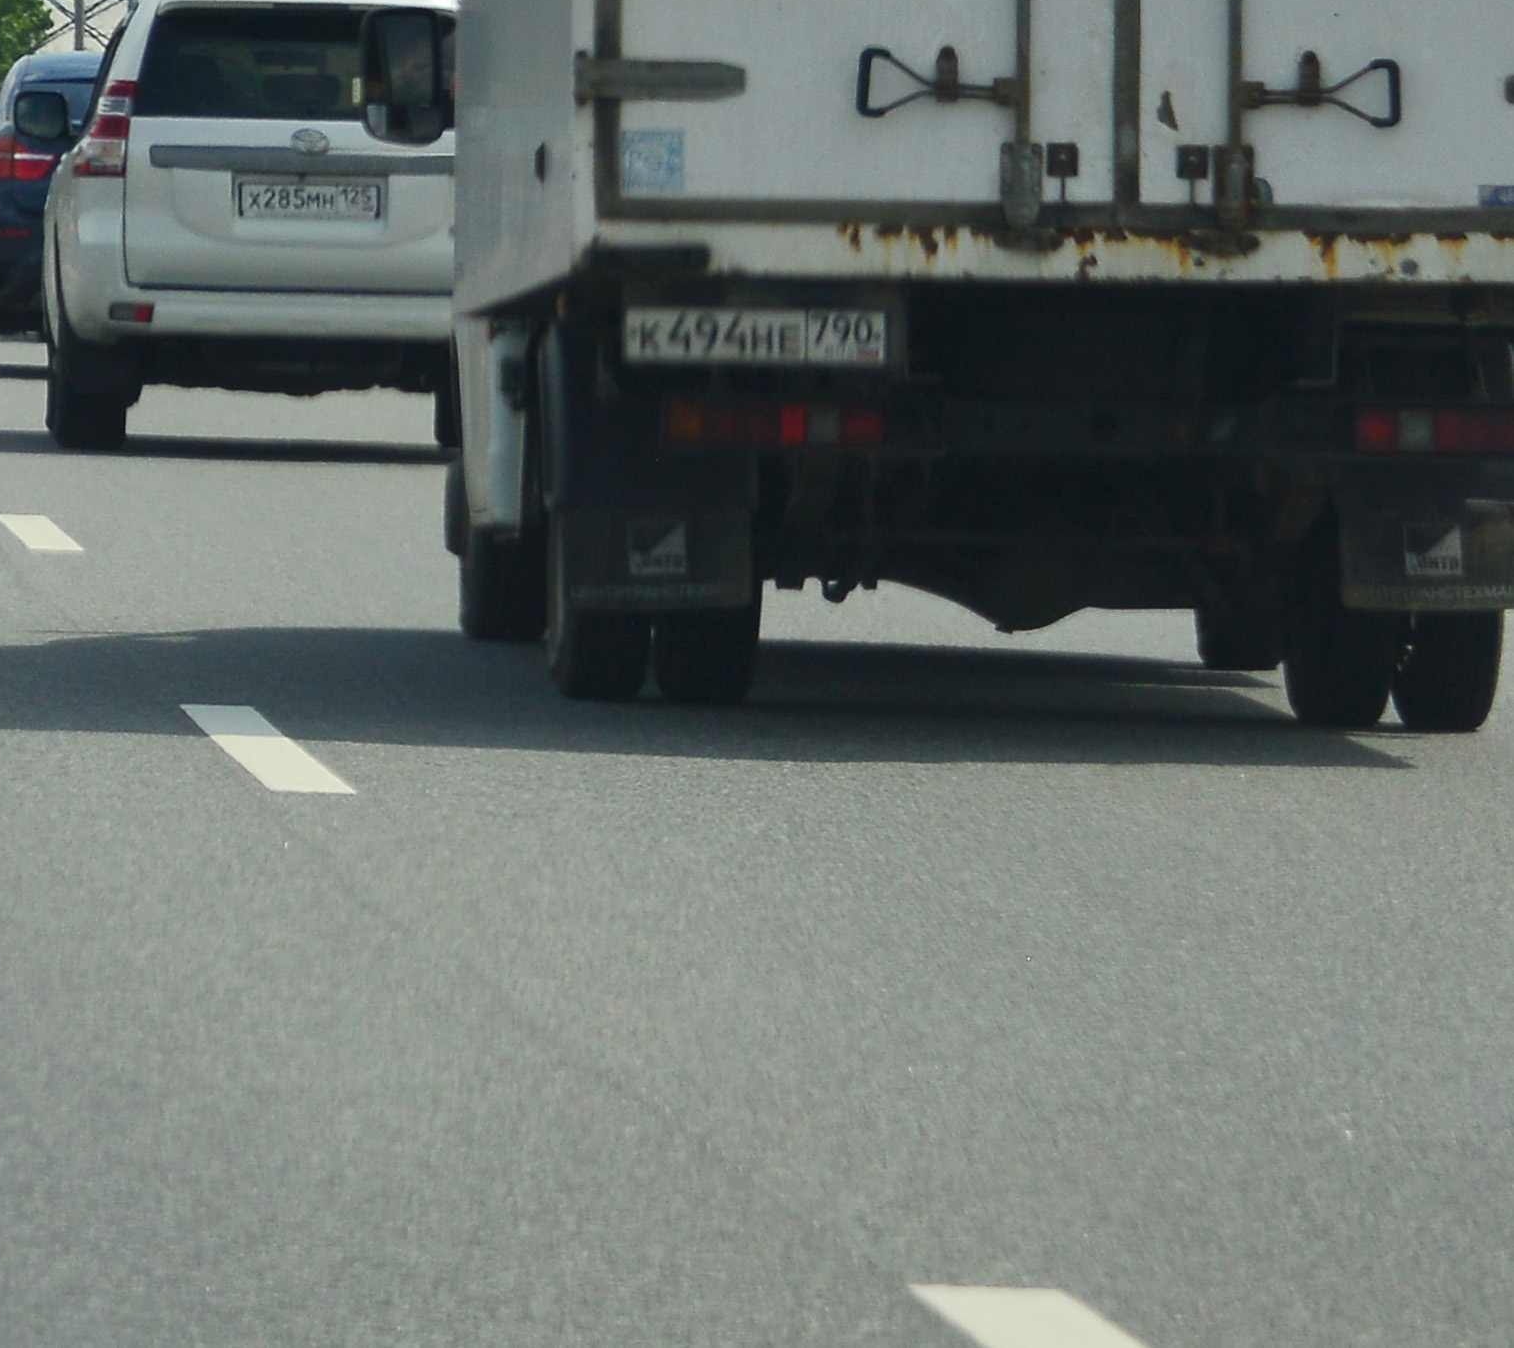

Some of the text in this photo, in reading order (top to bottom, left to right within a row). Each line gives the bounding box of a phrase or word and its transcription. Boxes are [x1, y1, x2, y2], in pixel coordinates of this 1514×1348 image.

[249, 188, 335, 210] Х285МН
[638, 311, 872, 353] К494НЕ 790
